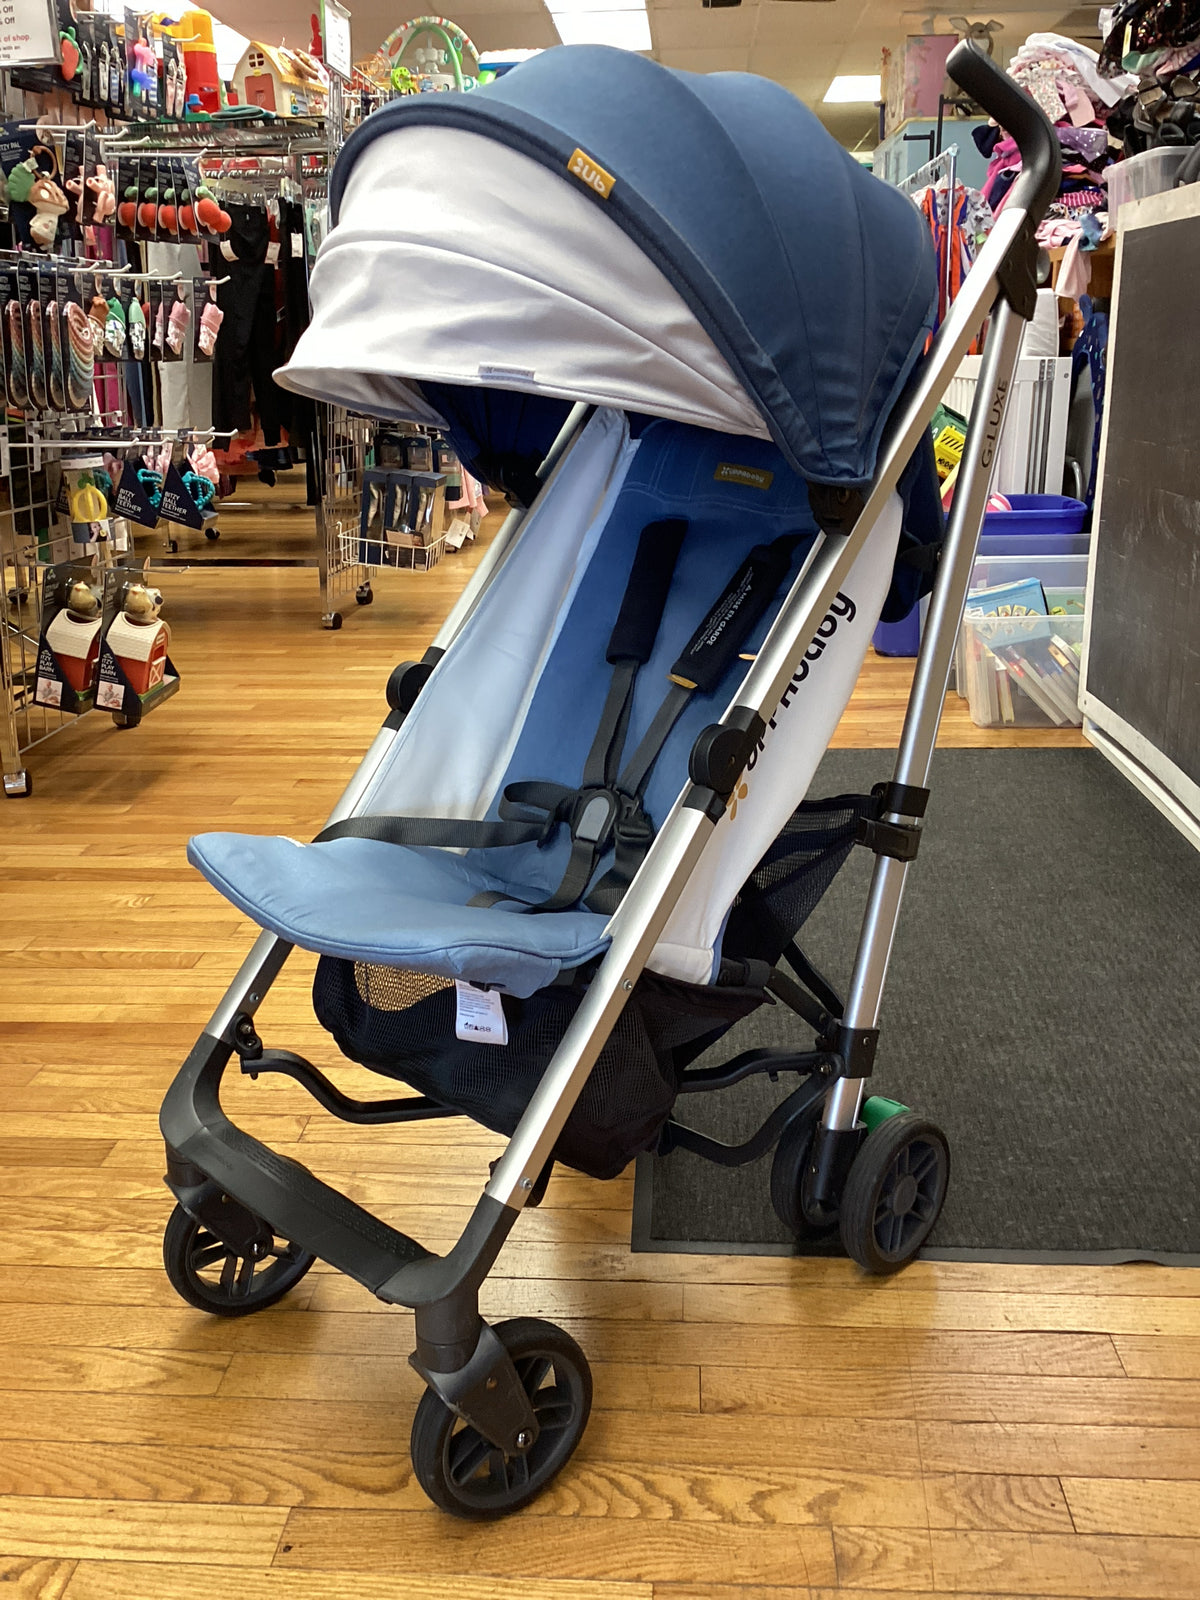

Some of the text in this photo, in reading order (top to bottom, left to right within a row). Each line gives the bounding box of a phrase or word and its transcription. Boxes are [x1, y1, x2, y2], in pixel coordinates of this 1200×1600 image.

[981, 378, 1008, 468] G-LUXE
[706, 592, 747, 646] MISE EN GARDE
